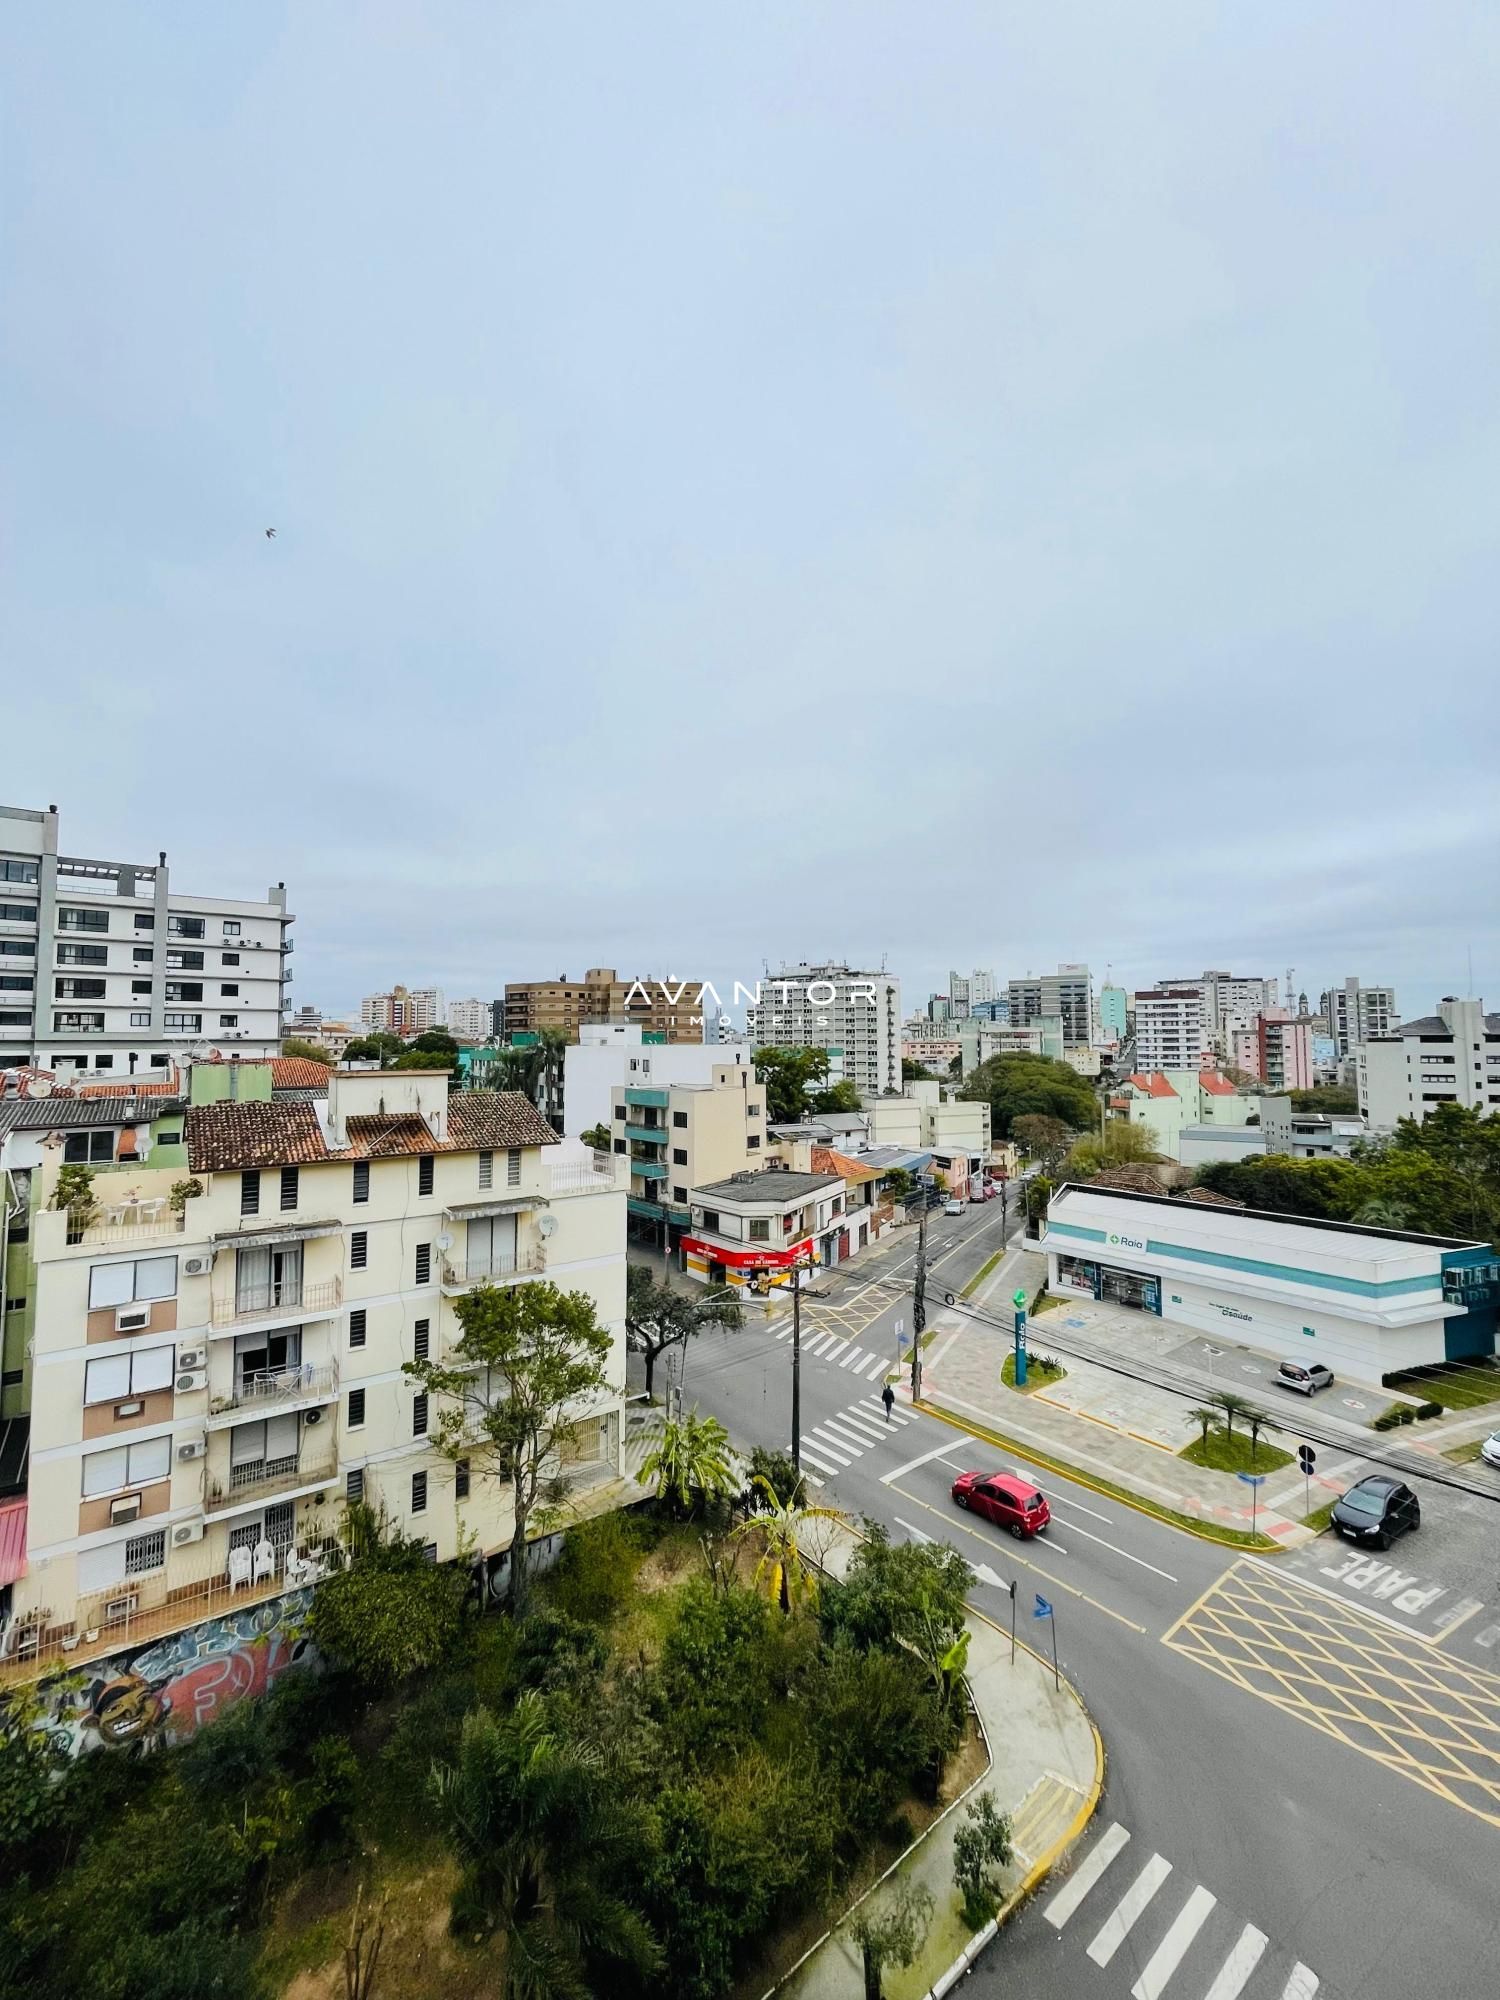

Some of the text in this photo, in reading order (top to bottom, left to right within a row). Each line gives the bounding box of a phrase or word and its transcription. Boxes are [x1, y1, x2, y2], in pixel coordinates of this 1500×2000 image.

[1121, 1236, 1143, 1249] Raia
[1018, 1323, 1026, 1350] Raia
[1319, 1551, 1450, 1615] PARE
